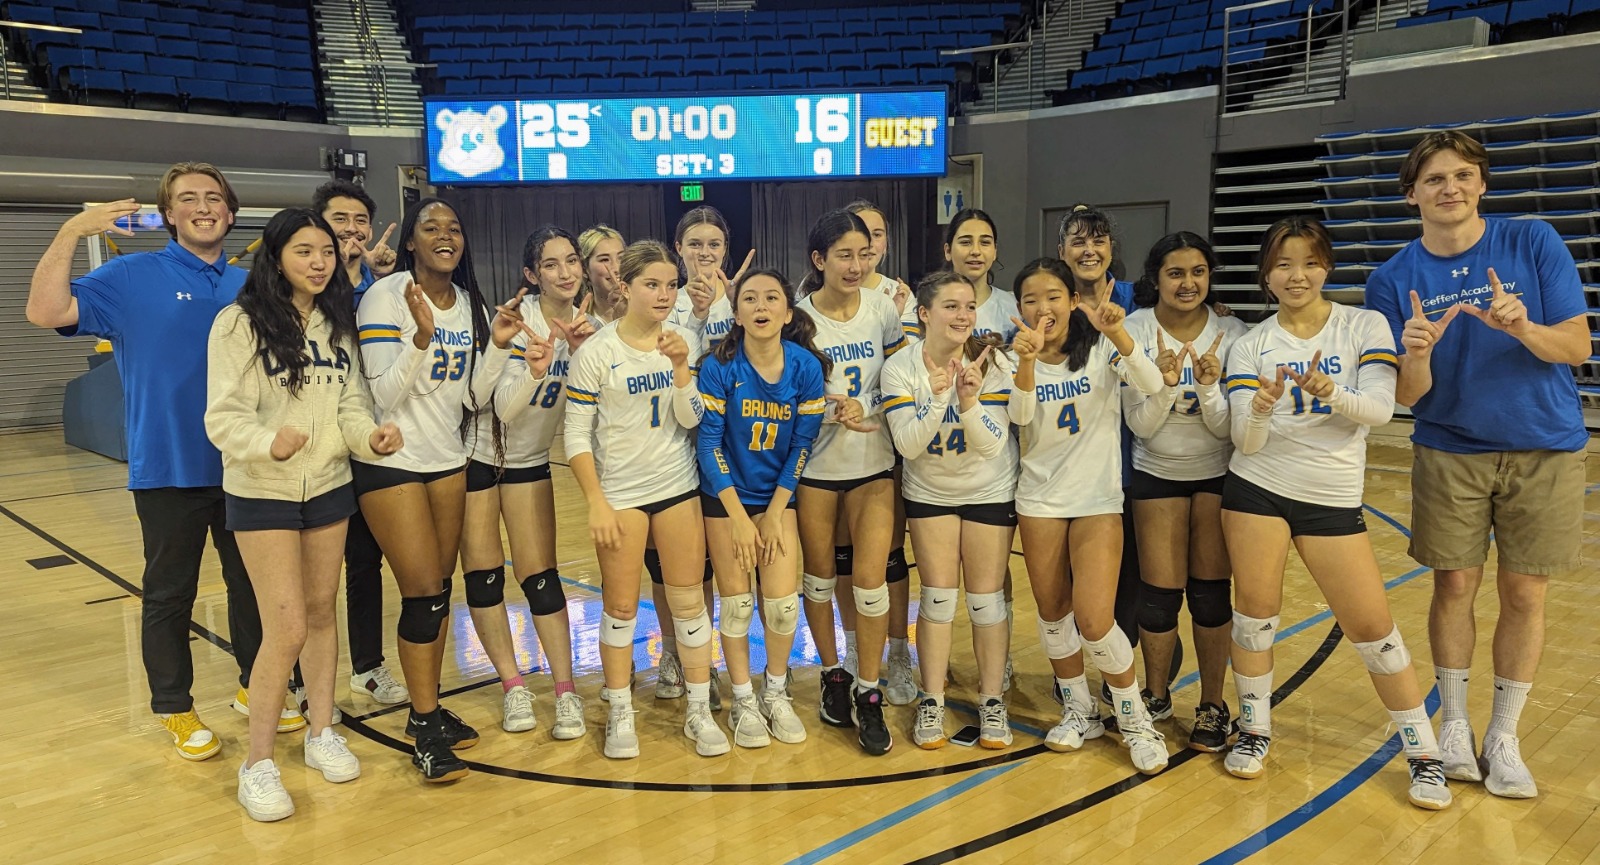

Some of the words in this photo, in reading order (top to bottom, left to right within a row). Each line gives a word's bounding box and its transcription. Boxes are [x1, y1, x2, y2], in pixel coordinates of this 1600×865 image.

[522, 102, 591, 148] 25
[631, 104, 737, 141] 01:00
[795, 97, 850, 143] 16
[865, 116, 938, 148] GUEST
[656, 153, 713, 176] SET:
[719, 153, 735, 175] 3
[813, 148, 833, 175] 0
[684, 185, 701, 200] EXIT
[1421, 292, 1459, 308] Geffen
[706, 318, 736, 336] UIN
[260, 340, 351, 377] ULA
[430, 350, 466, 381] 23
[547, 359, 570, 377] UIN
[1276, 356, 1343, 381] RNS
[279, 375, 345, 387] BUINS
[529, 380, 562, 409] 18
[844, 364, 862, 398] 3
[1036, 376, 1091, 403] BRUINS
[650, 395, 661, 429] 1
[741, 398, 791, 420] BRUINS
[1169, 391, 1202, 415] 7
[1057, 402, 1081, 436] 4
[748, 421, 778, 451] 11
[713, 447, 730, 474] GEFF
